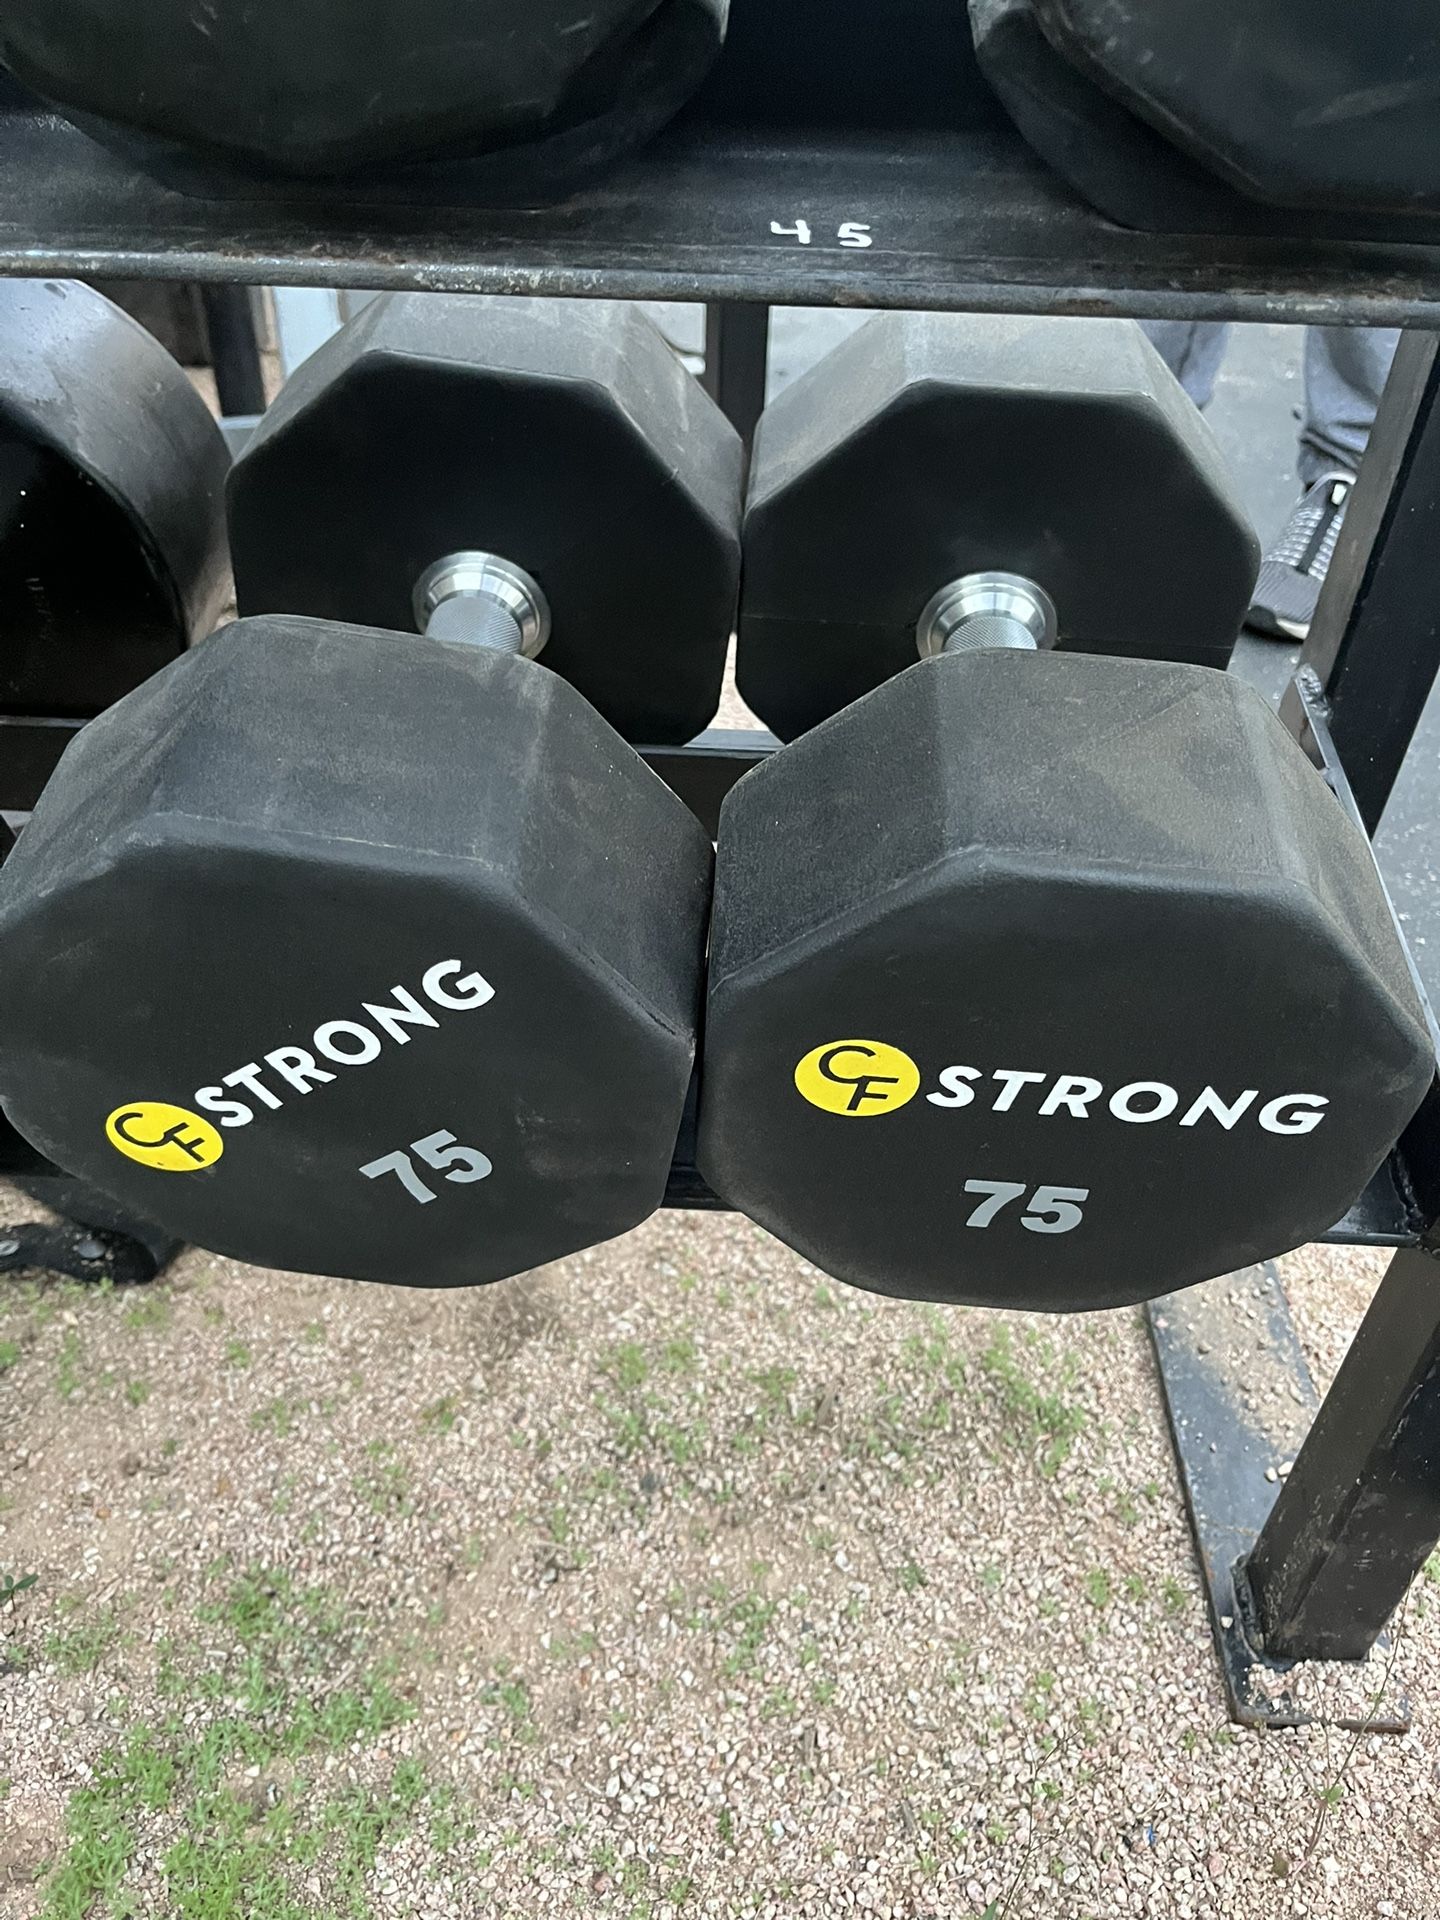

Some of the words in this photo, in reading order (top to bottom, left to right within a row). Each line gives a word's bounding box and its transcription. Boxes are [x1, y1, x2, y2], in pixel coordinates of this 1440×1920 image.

[113, 1111, 210, 1164] CF
[194, 958, 496, 1129] STRONG
[817, 1044, 900, 1112] CF
[925, 1065, 1330, 1136] STRONG
[358, 1128, 493, 1204] 75
[964, 1179, 1090, 1234] 75
